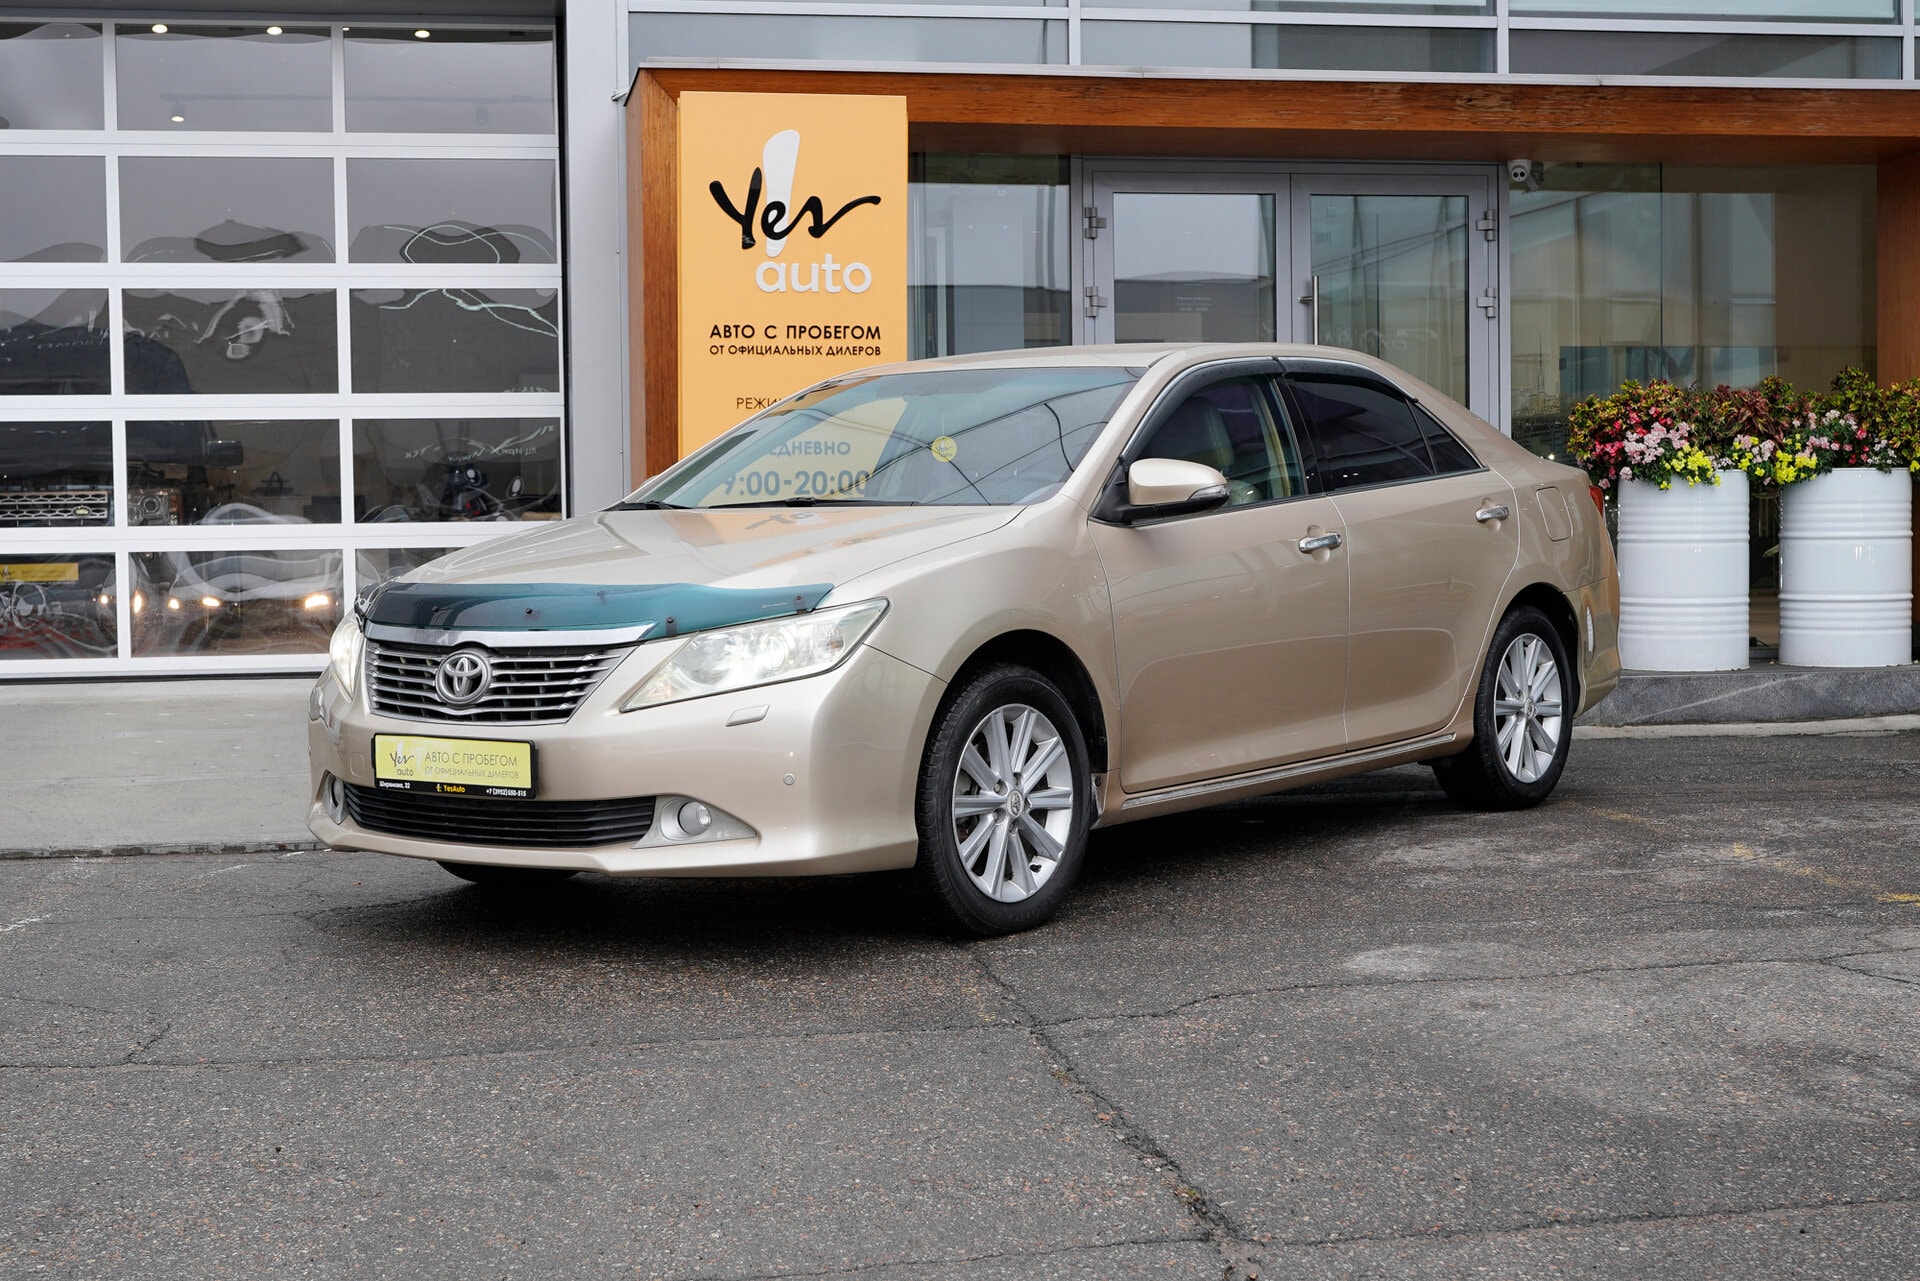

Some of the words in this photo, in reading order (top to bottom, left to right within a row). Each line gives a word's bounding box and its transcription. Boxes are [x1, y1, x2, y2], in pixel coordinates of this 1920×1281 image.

[755, 253, 872, 293] auto
[709, 324, 755, 339] АВТО
[764, 325, 777, 339] С
[786, 325, 881, 340] ПРОБЕГОМ
[709, 345, 724, 355] ОТ
[728, 344, 823, 356] ОФИЦИАЛЬНЫХ
[826, 345, 881, 356] ДИЛЕРОВ
[736, 397, 782, 410] РЕЖИ
[425, 752, 450, 763] АВТО
[452, 752, 460, 764] С
[462, 753, 517, 767] ПРОБЕГОМ
[396, 768, 414, 776] auto
[425, 766, 433, 775] ОТ
[435, 766, 486, 777] ОФИЦИАЛЬНЫХ
[487, 770, 519, 779] ДИЛЕРОВ
[443, 784, 466, 793] YesAuto
